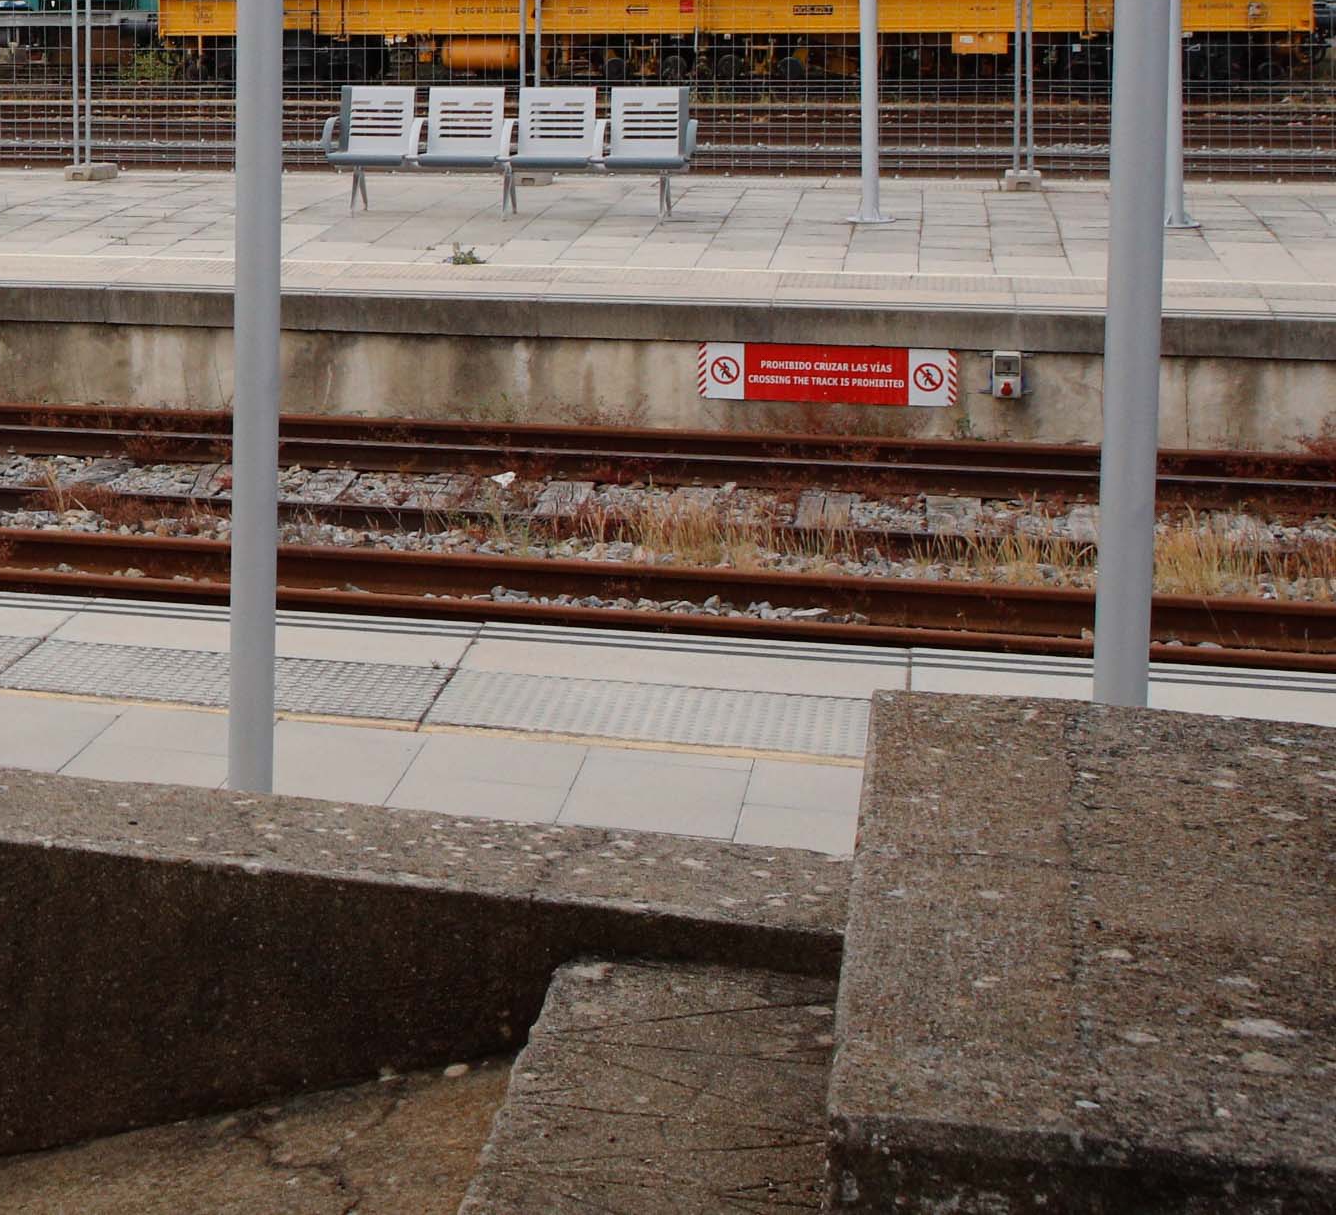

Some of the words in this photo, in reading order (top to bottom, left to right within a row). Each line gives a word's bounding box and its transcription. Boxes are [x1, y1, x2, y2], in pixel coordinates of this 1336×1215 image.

[760, 360, 812, 371] PROHIBIDO
[813, 361, 849, 372] CRUZAR
[851, 362, 868, 372] LAS
[870, 361, 893, 373] VÍAS
[748, 374, 791, 385] CROSSING
[793, 376, 810, 385] THE
[812, 376, 838, 387] TRACK
[840, 377, 850, 386] IS
[852, 378, 905, 388] PROHIBITED
